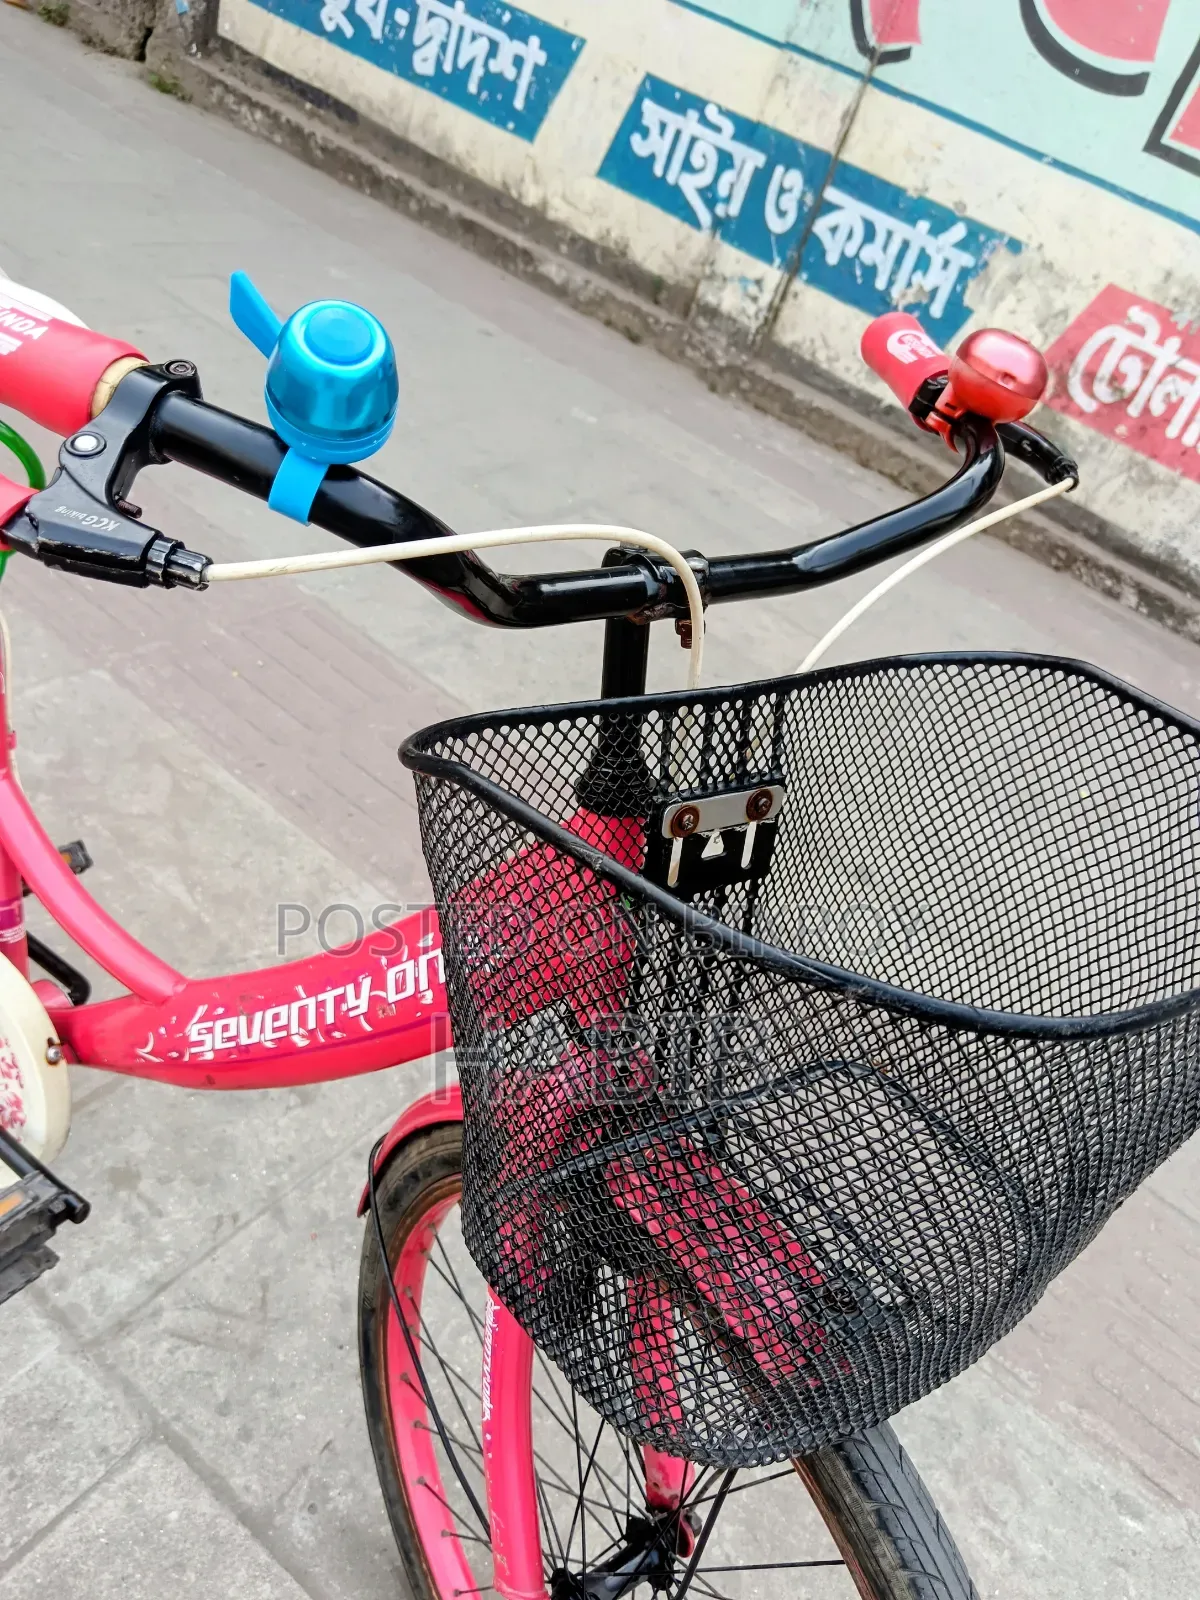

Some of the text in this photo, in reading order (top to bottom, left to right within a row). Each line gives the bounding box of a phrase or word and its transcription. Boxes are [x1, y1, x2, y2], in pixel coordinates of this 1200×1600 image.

[764, 165, 805, 235] ও
[811, 185, 976, 319] কমার্স
[81, 514, 121, 532] KCG
[386, 947, 447, 1004] on
